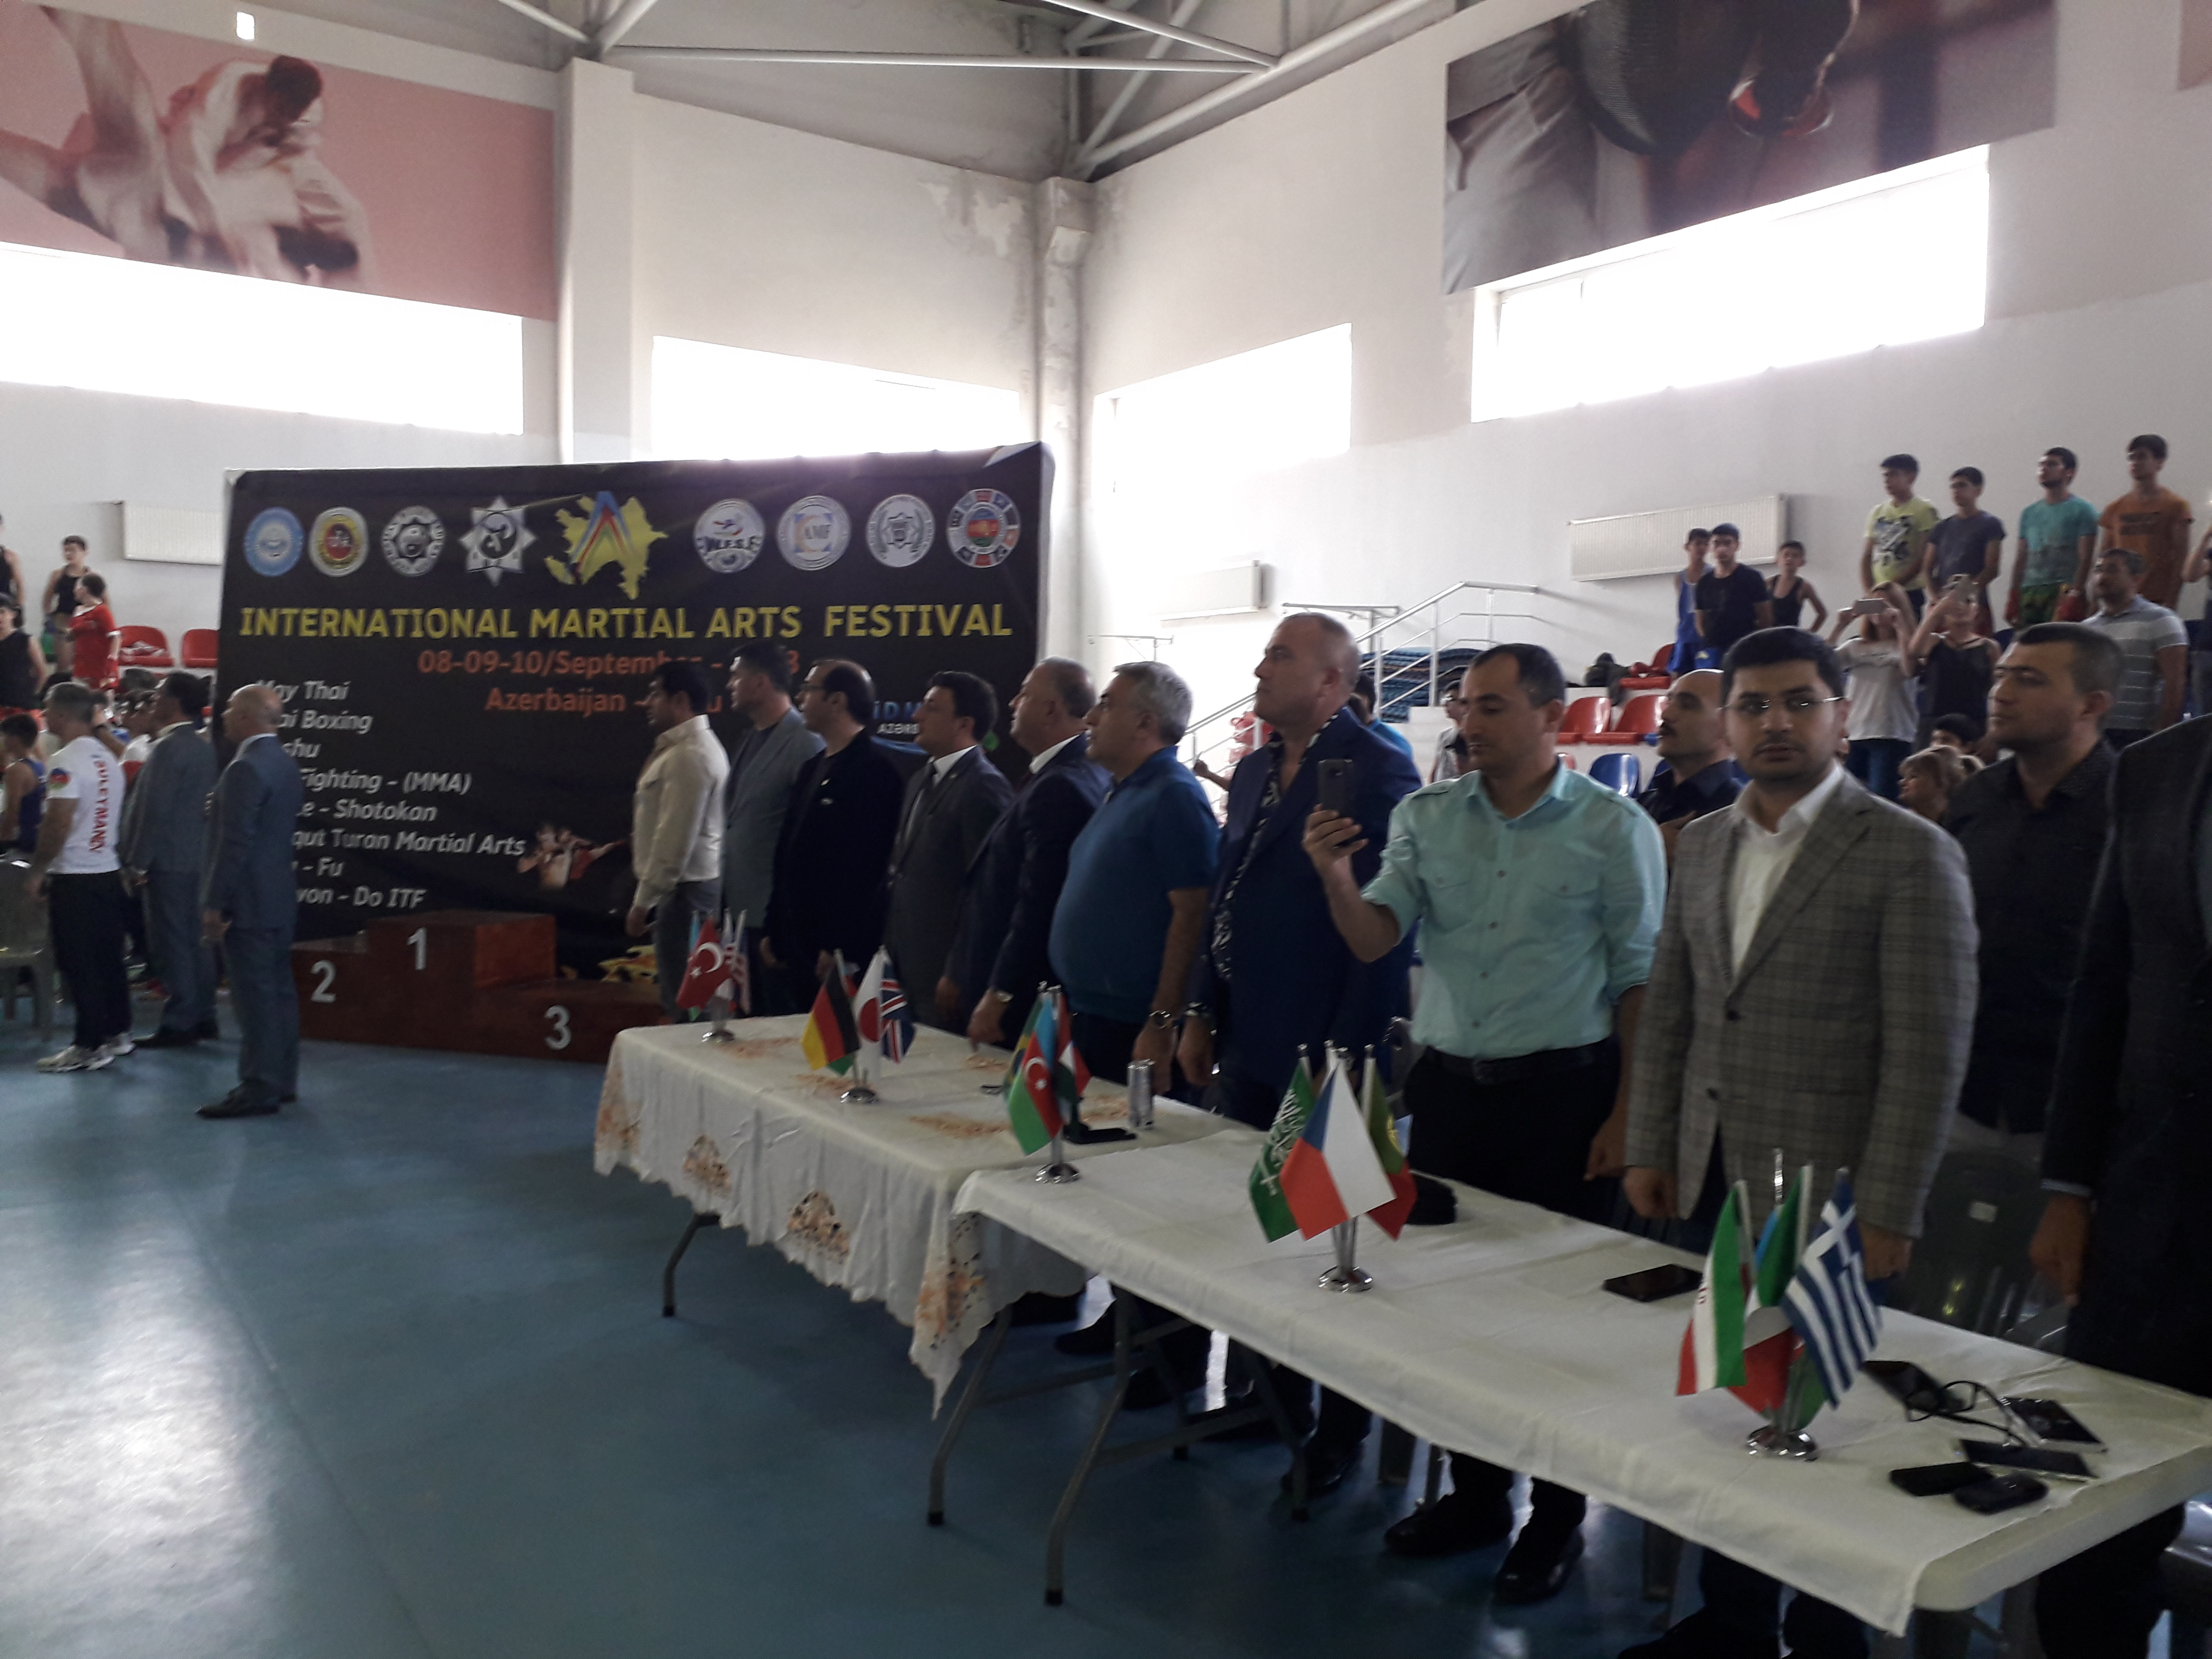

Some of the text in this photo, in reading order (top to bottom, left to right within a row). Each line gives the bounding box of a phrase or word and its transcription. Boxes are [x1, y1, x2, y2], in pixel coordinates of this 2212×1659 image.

[239, 603, 1013, 638] INTERNATIONAL MARTIAL ARTS FESTIVAL
[303, 680, 352, 701] Thai
[484, 686, 626, 718] Azerbaijan
[300, 709, 374, 735] Boxing
[403, 771, 473, 796] (MMA)
[331, 797, 439, 822] Shotokan
[330, 827, 392, 849] Turan
[393, 830, 476, 854] Martial
[475, 833, 527, 856] Arts
[316, 856, 346, 878] Fu
[352, 884, 384, 907] Do
[386, 887, 428, 910] ITF
[406, 926, 428, 972] 1
[310, 960, 337, 1004] 2
[544, 1004, 571, 1047] 3
